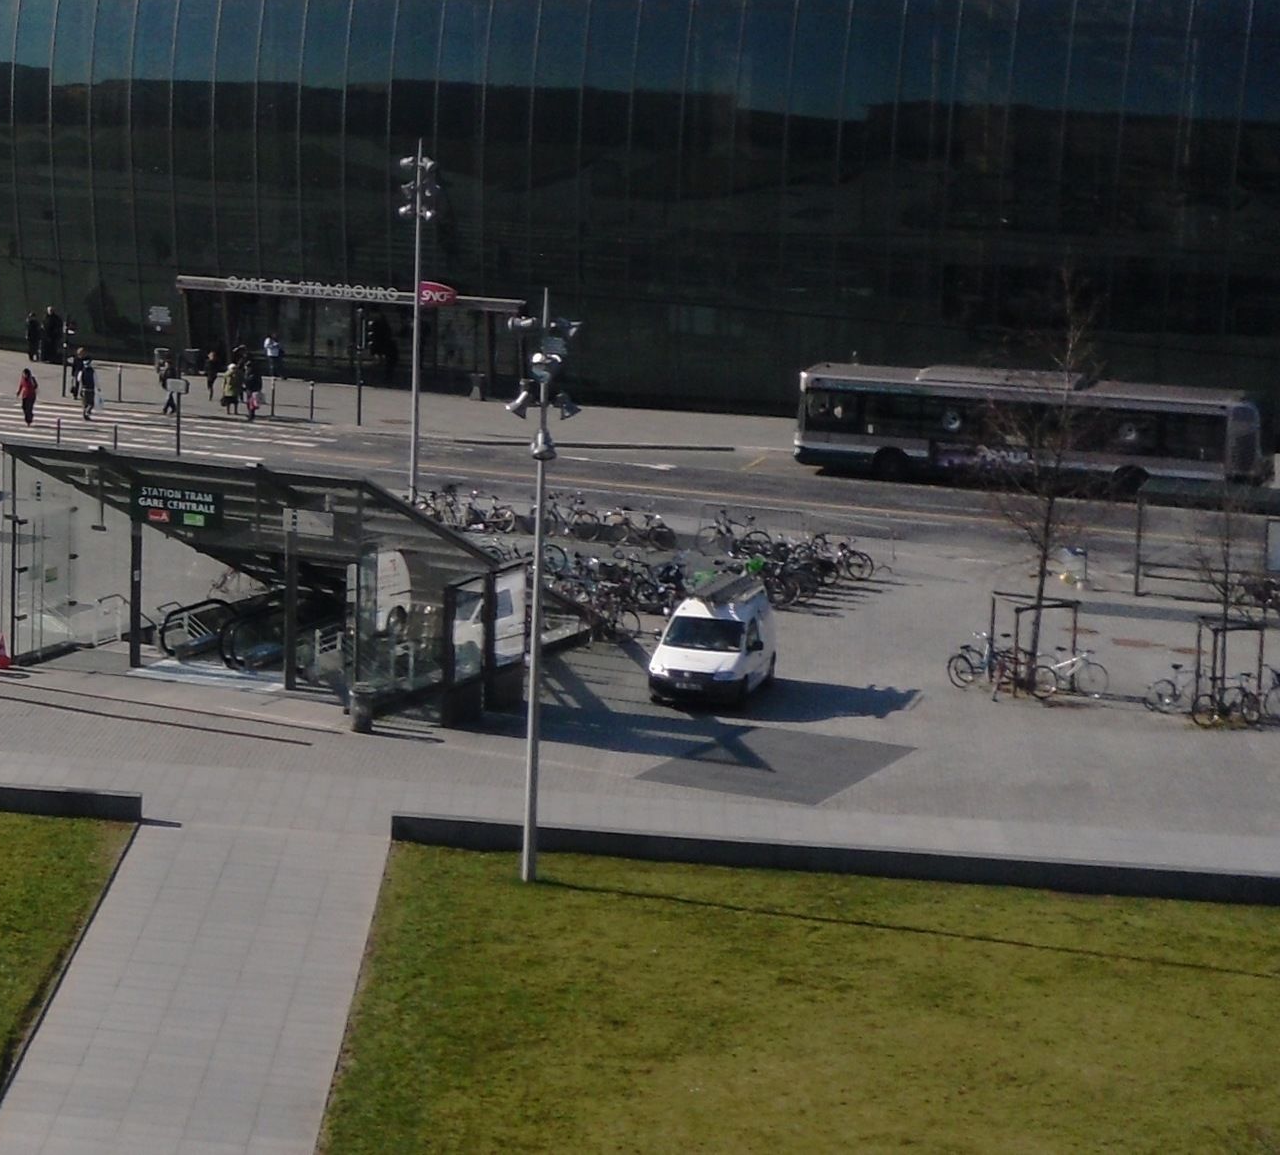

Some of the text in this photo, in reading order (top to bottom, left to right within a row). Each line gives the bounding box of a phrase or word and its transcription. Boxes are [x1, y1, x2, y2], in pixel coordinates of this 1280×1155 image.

[226, 276, 398, 301] GARE DE STRASBOURG
[421, 289, 451, 302] SNCF
[141, 487, 213, 502] STATION TRAM
[138, 497, 215, 514] GARE CENTRALE
